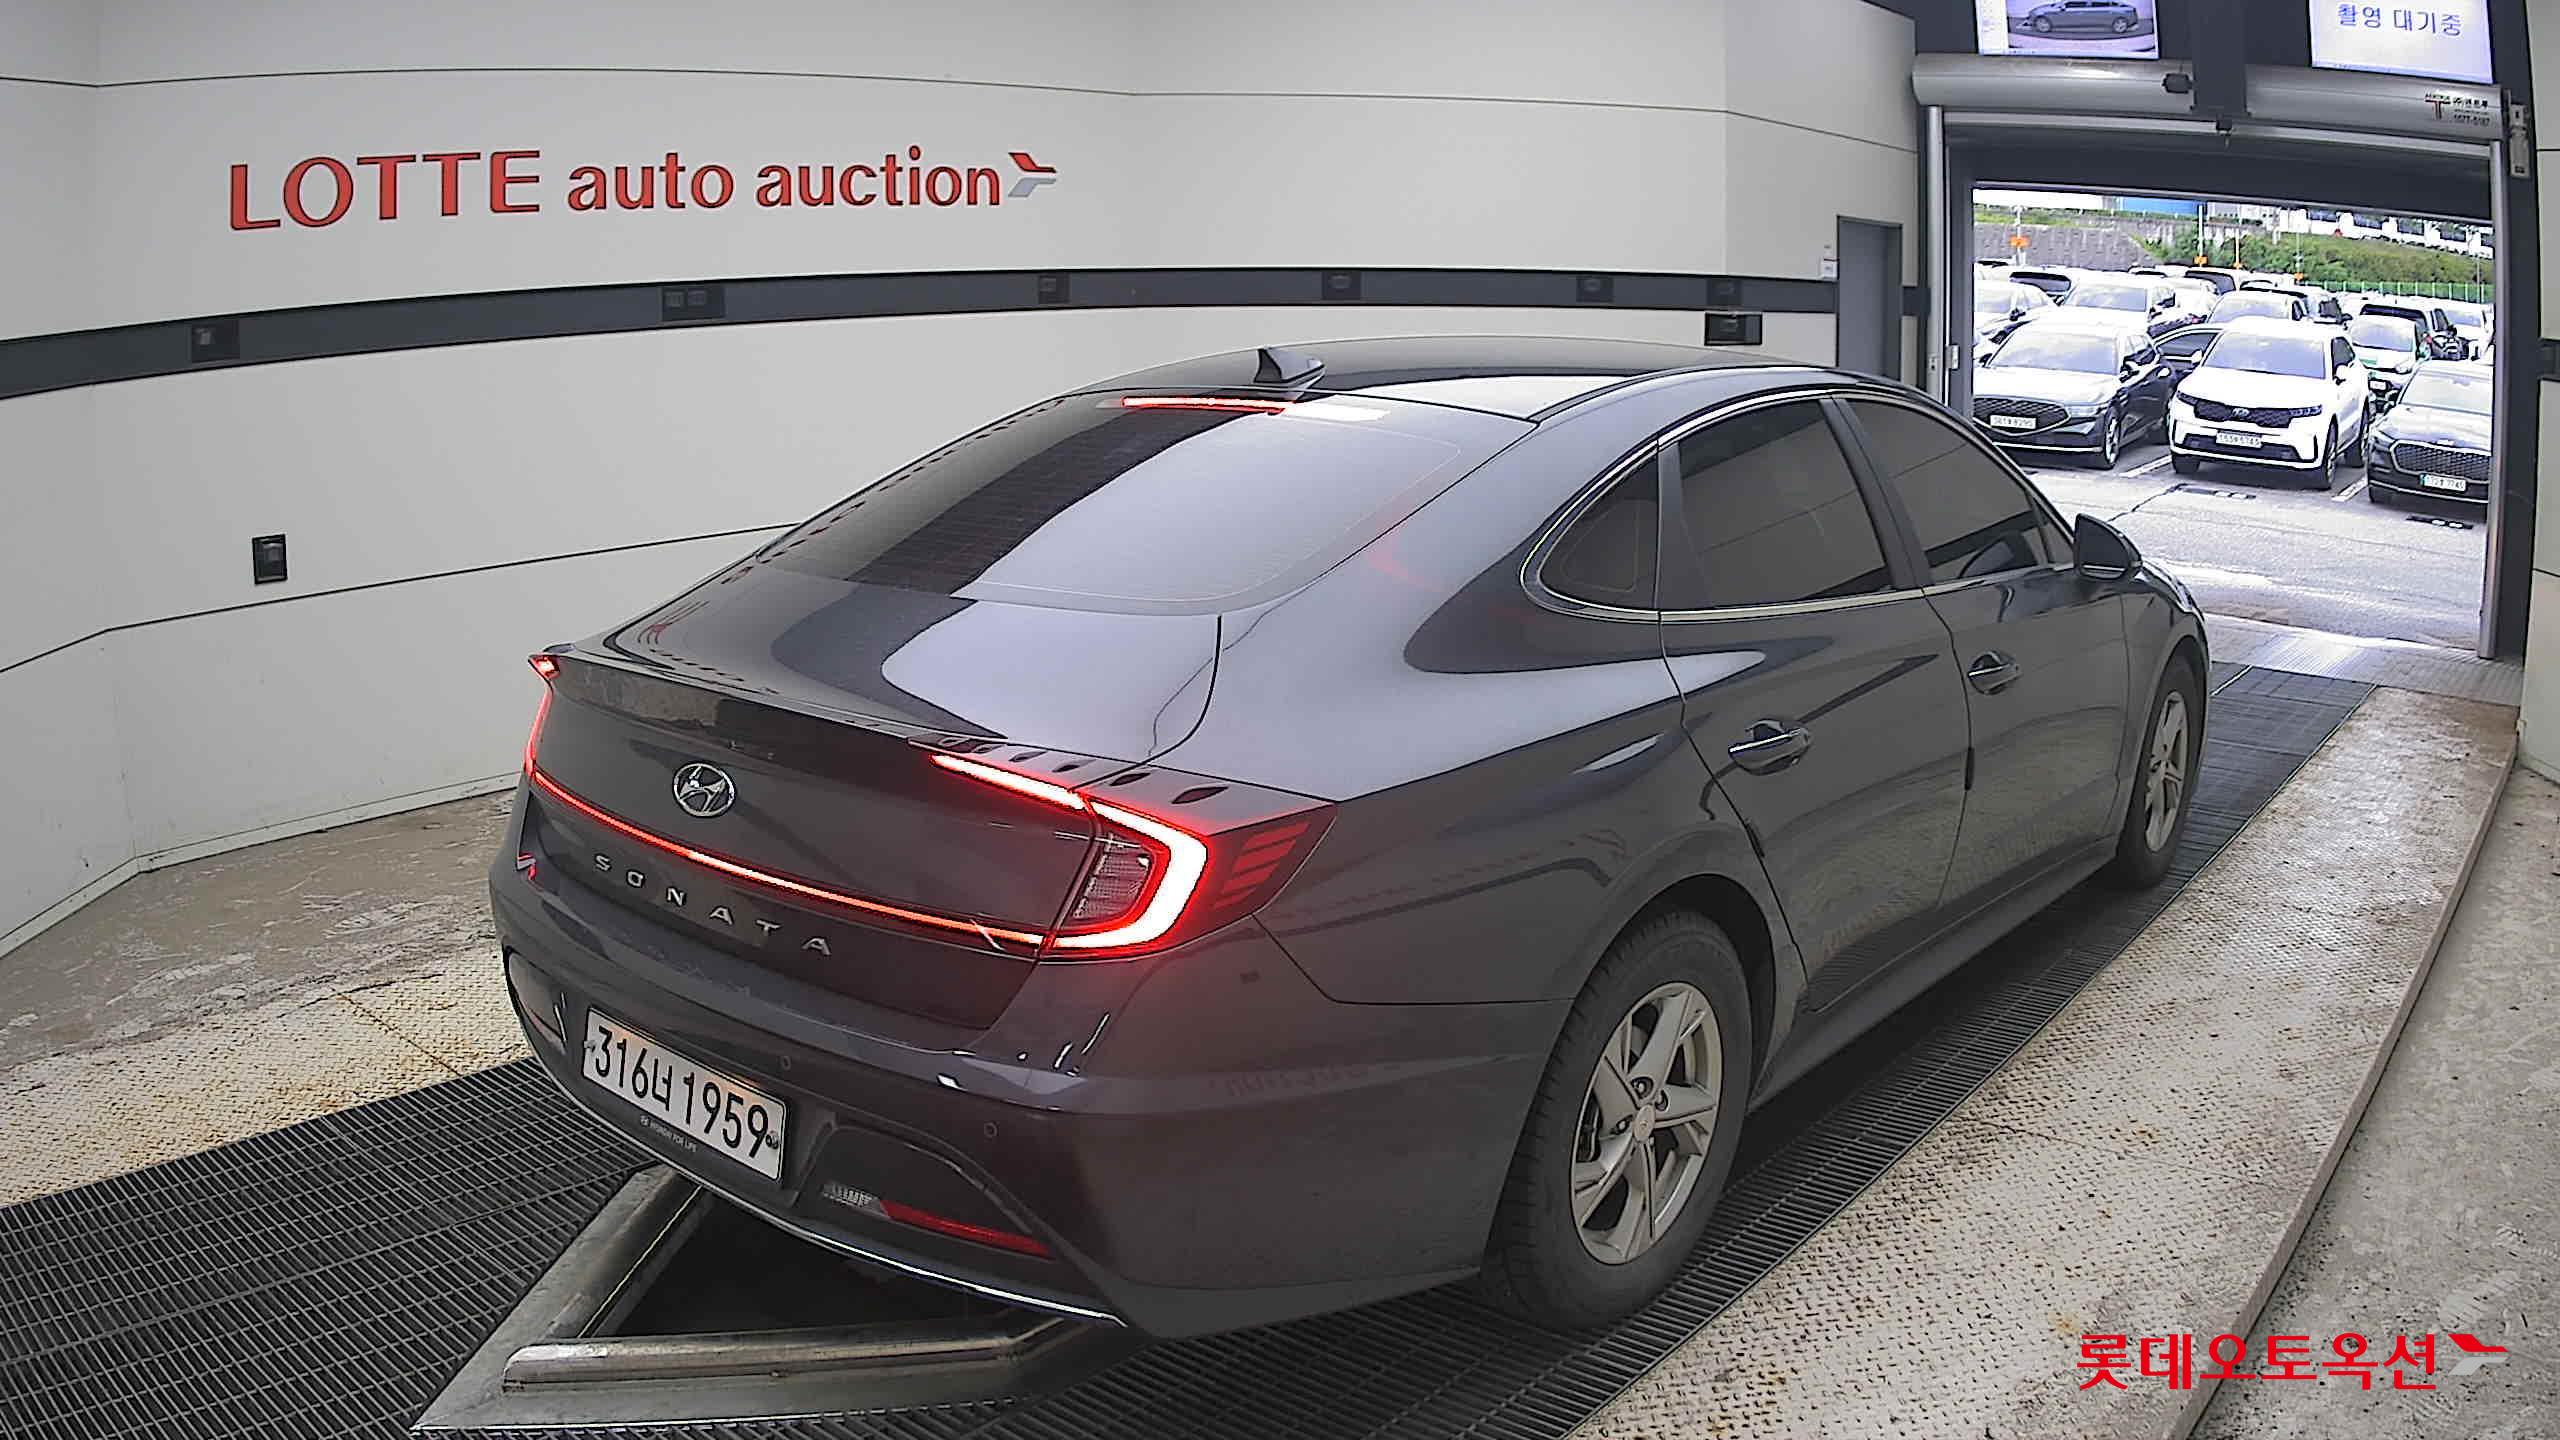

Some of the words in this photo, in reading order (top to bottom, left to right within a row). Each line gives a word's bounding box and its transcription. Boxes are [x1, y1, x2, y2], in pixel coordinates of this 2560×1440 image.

[2338, 3, 2382, 29] 촬영
[2393, 9, 2462, 37] 대기중
[229, 150, 541, 231] LOTTE
[567, 151, 735, 211] auto
[755, 144, 1002, 208] auction
[594, 853, 832, 956] SONATA
[595, 1024, 770, 1159] 316너1959
